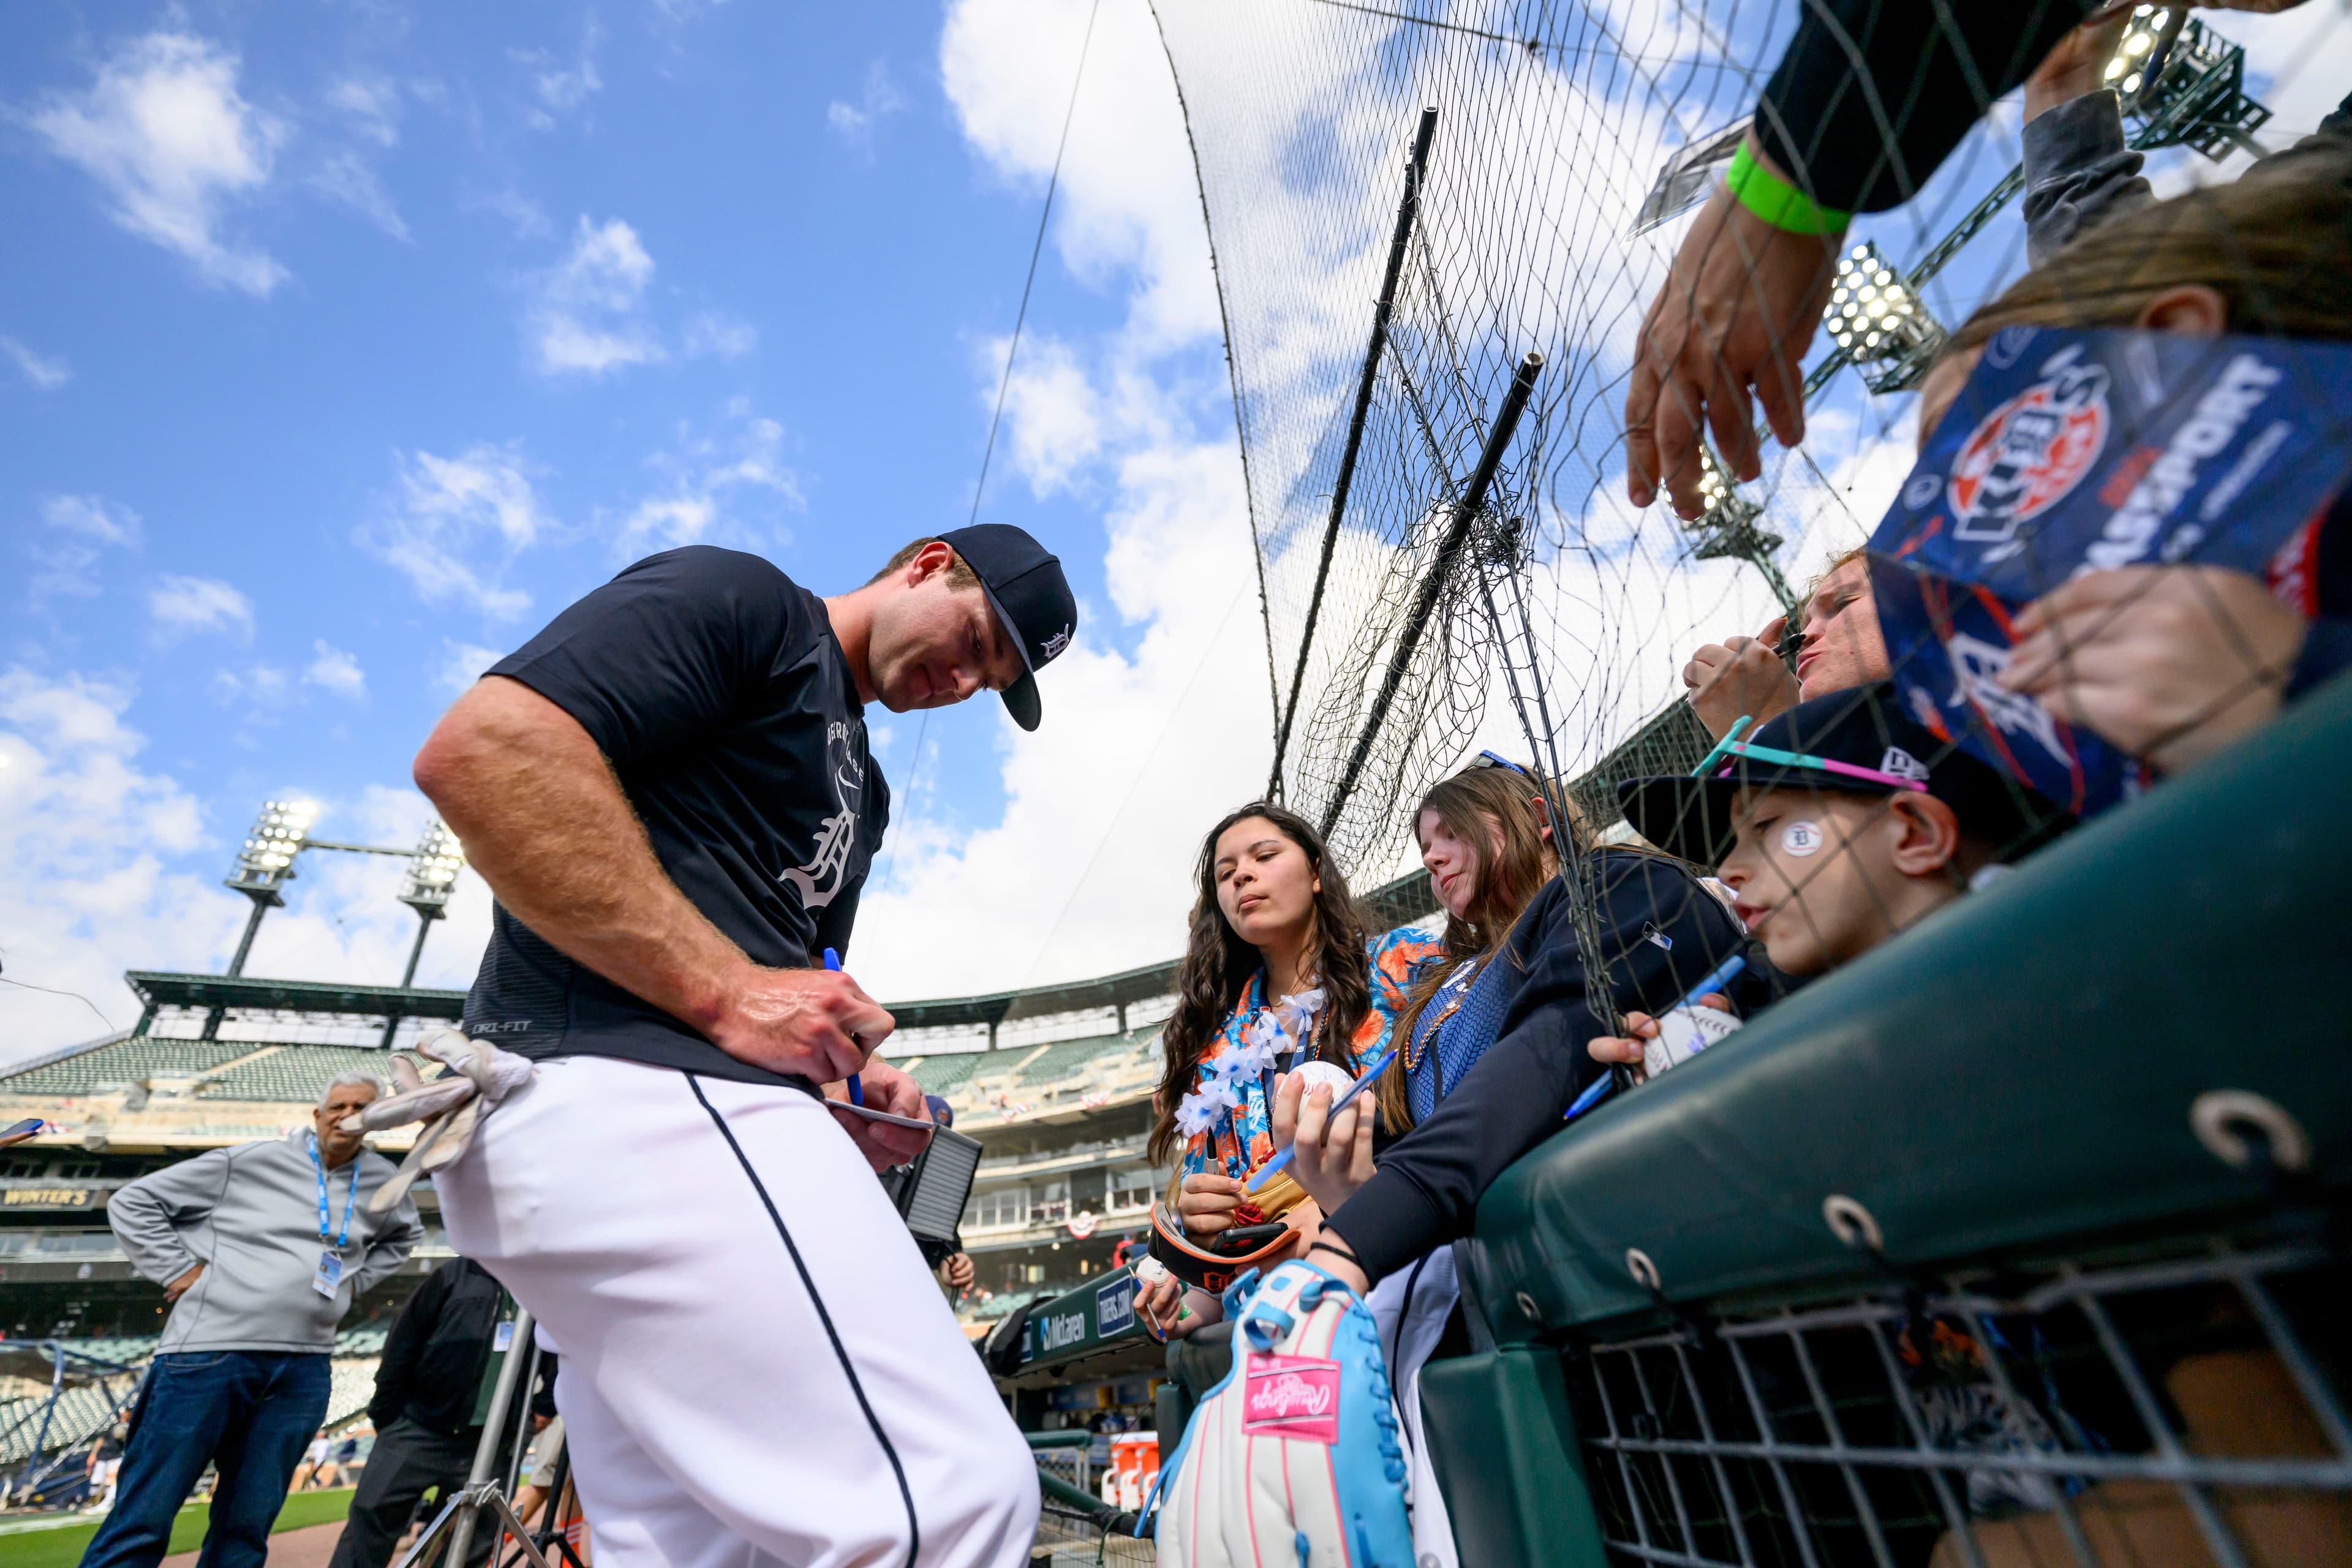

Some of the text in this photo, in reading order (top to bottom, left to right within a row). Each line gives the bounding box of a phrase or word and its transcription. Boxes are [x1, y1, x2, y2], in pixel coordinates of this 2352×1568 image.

[2070, 352, 2283, 579] ASSPORT
[472, 1020, 532, 1035] DRI-FIT
[1099, 1289, 1130, 1325] TIGERS.COM
[1052, 1313, 1085, 1349] McLaren
